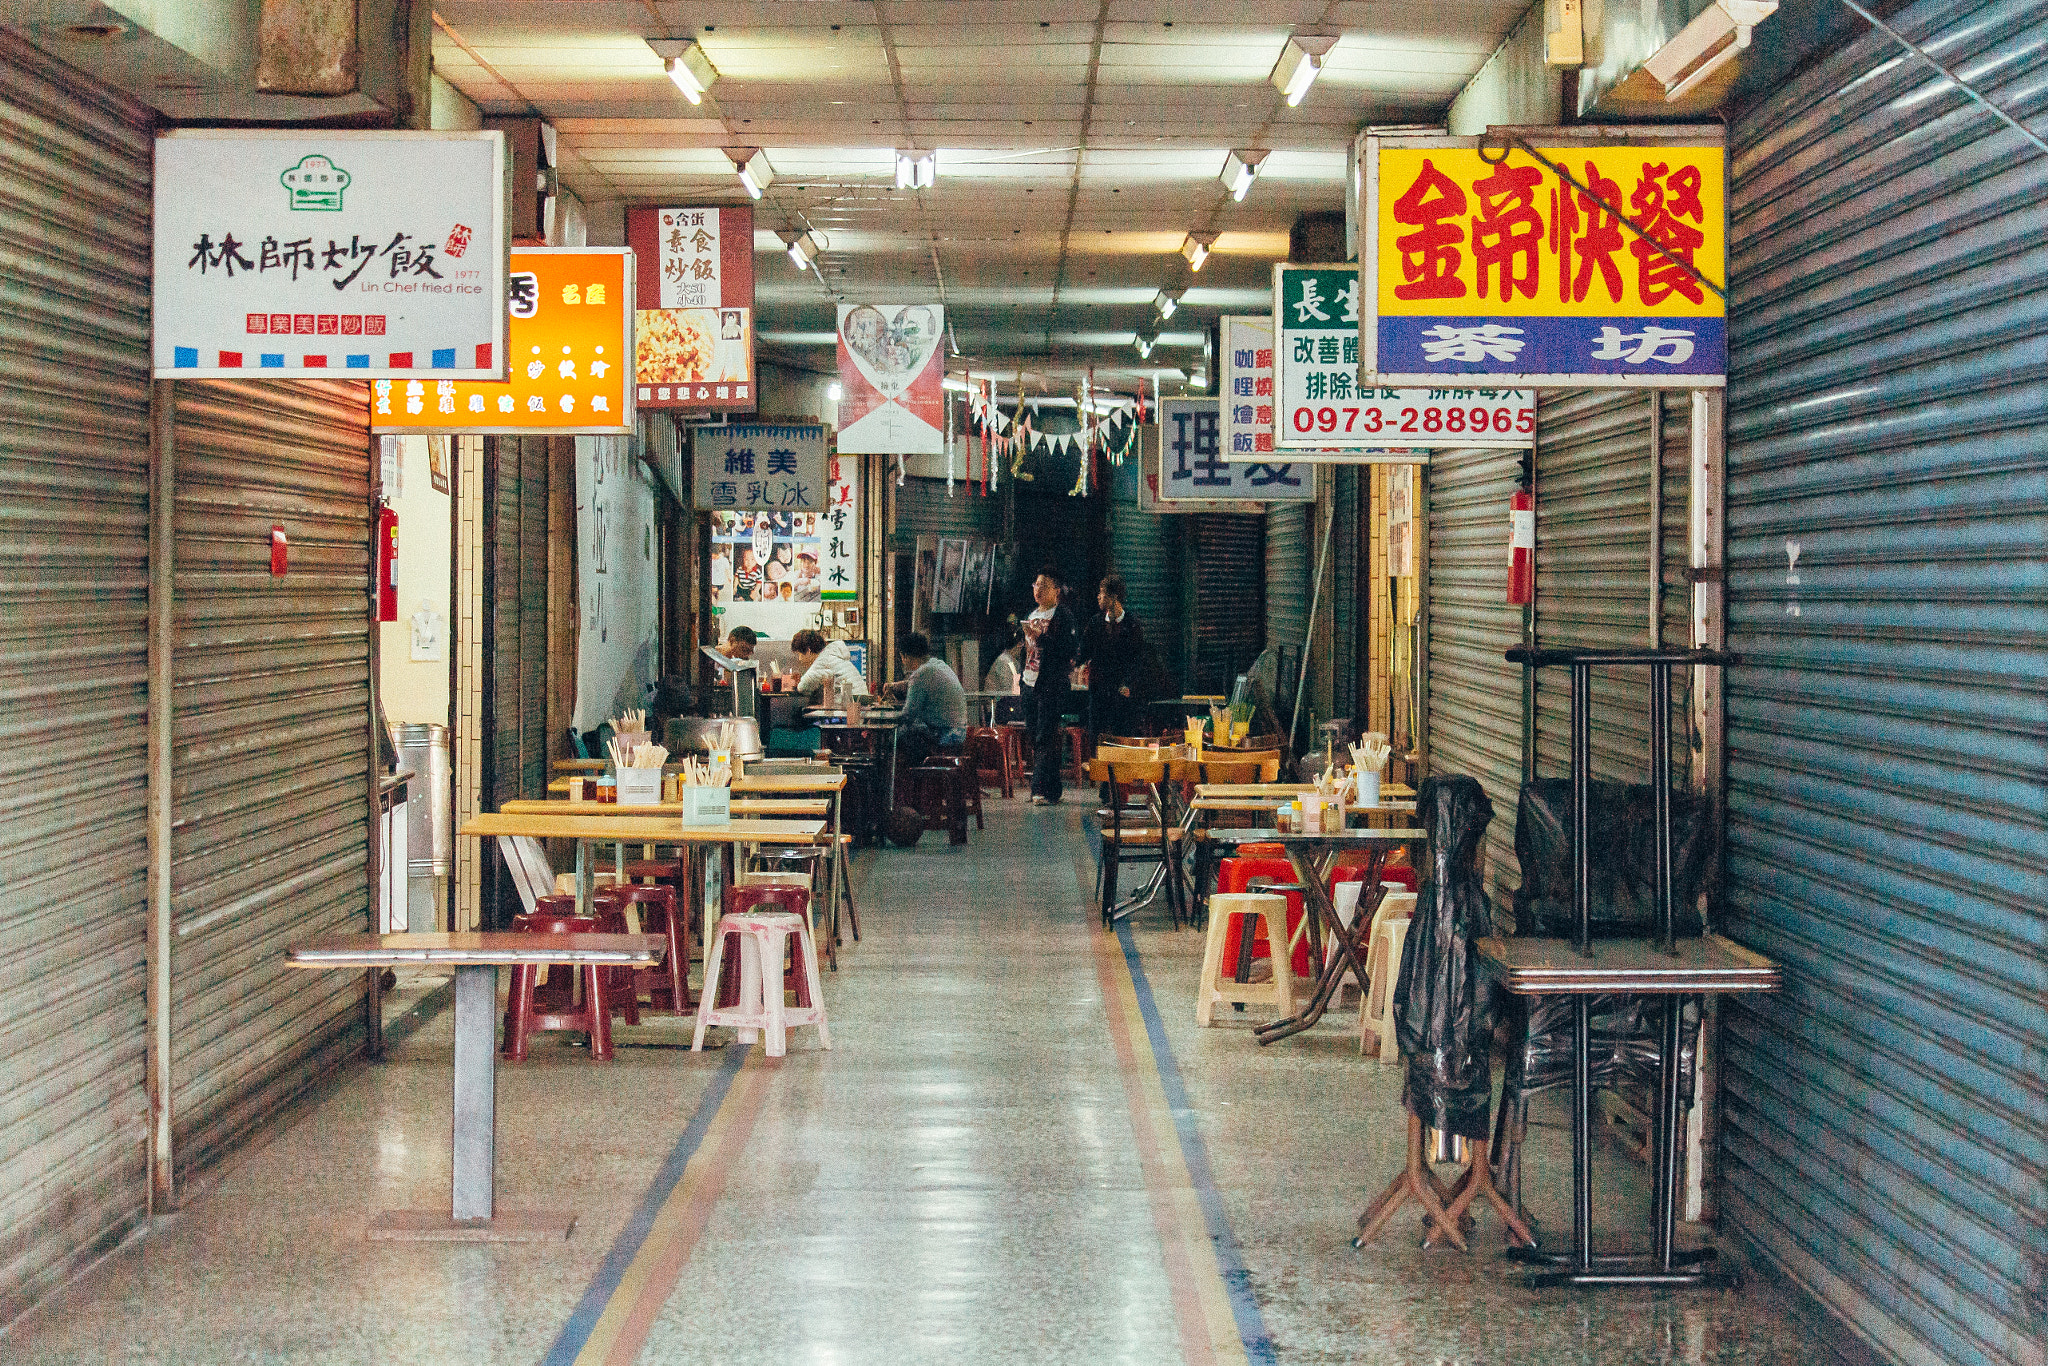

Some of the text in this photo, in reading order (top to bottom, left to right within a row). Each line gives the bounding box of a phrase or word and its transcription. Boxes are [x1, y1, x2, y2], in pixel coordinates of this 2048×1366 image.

[666, 228, 715, 253] 素食
[1394, 158, 1705, 306] 金帝快餐
[189, 232, 444, 290] 林師炒飯
[665, 258, 716, 283] 炒飯
[455, 270, 480, 279] 1977
[361, 281, 482, 294] Lin Chef fried rice
[562, 284, 606, 304] 名產
[246, 314, 386, 335] 專業美式炒飯
[1421, 324, 1695, 363] 茶坊
[1233, 349, 1254, 453] 咖哩燴飯
[1293, 406, 1534, 434] 0973-288965
[725, 448, 797, 475] 維美
[710, 481, 810, 506] 雪乳冰
